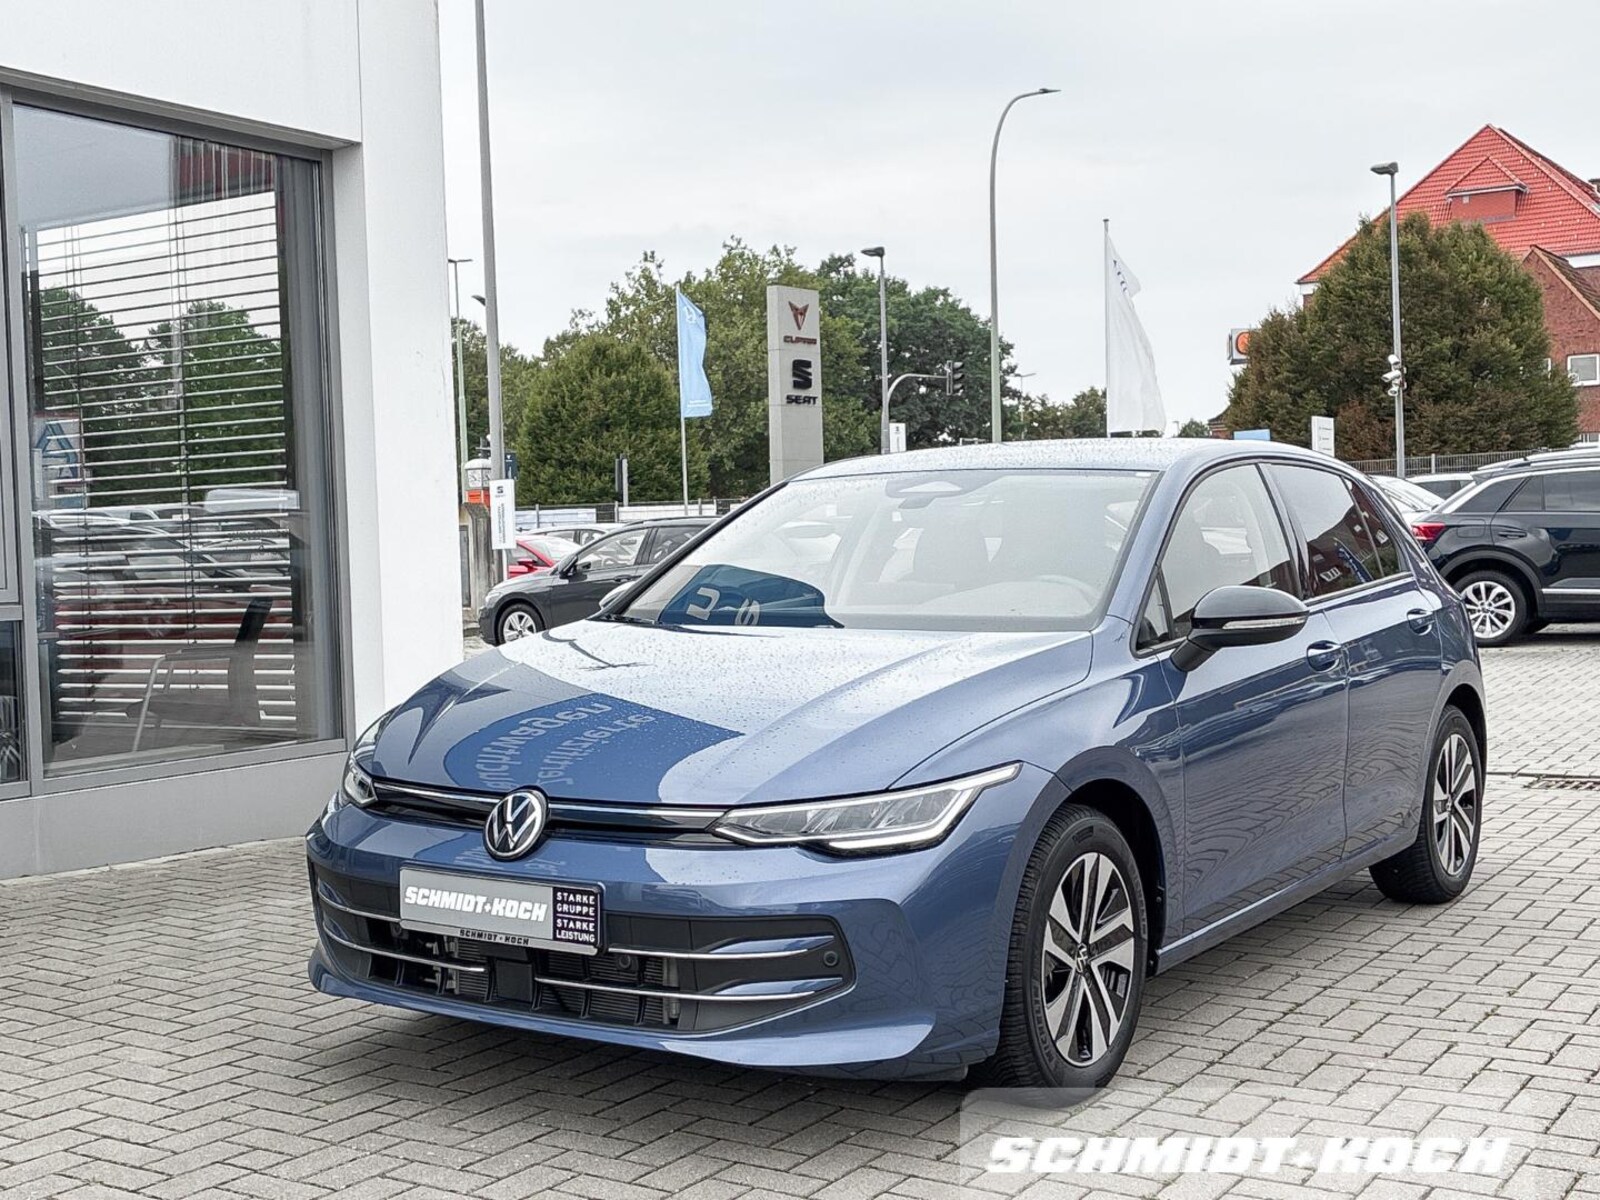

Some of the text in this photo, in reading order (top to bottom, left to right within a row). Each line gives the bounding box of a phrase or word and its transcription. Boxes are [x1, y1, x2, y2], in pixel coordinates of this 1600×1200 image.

[786, 394, 818, 405] SEAT
[556, 891, 596, 905] STARKE
[556, 903, 596, 916] GRUPPE
[556, 918, 596, 932] STARKE
[460, 929, 498, 942] SCHMIDT
[504, 935, 529, 945] KOCH
[556, 929, 596, 943] LEISTUNG
